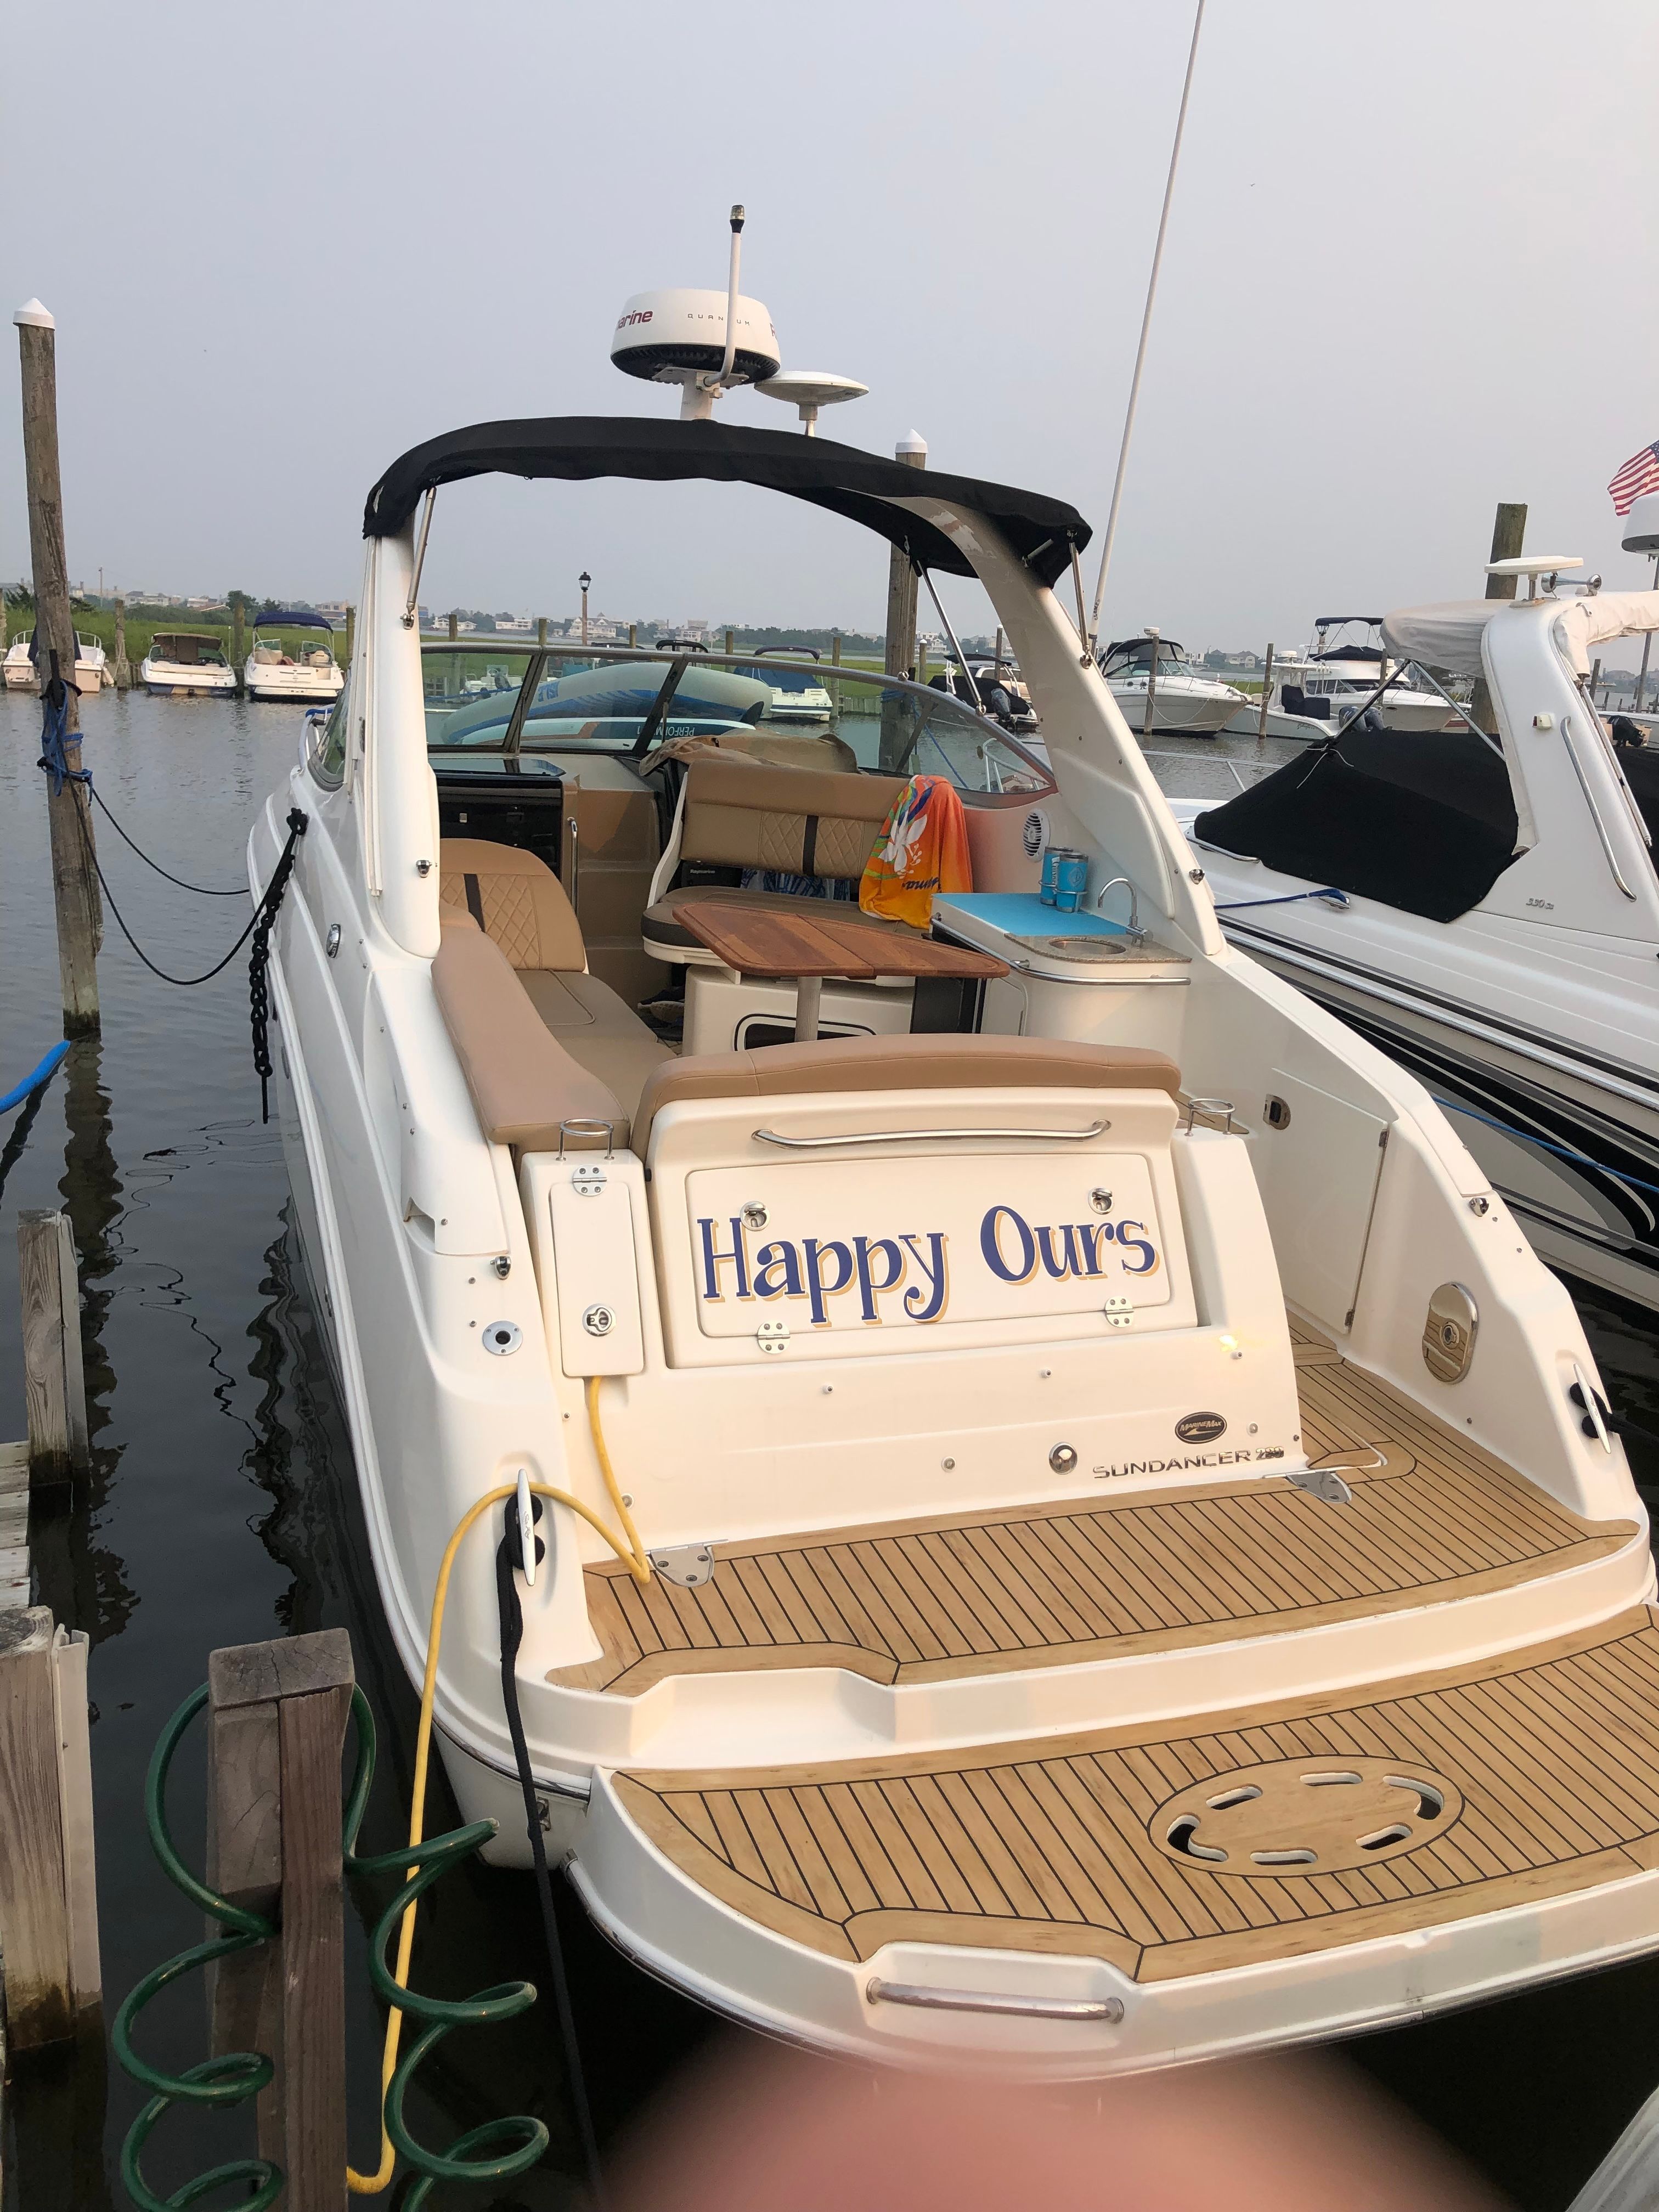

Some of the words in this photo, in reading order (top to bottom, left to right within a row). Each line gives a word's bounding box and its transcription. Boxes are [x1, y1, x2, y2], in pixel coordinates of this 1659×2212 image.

[616, 309, 653, 330] arine
[687, 313, 750, 326] QUANUM
[697, 1211, 949, 1328] Happy
[980, 1205, 1160, 1286] Ours
[1093, 1449, 1251, 1479] SUNDANCER
